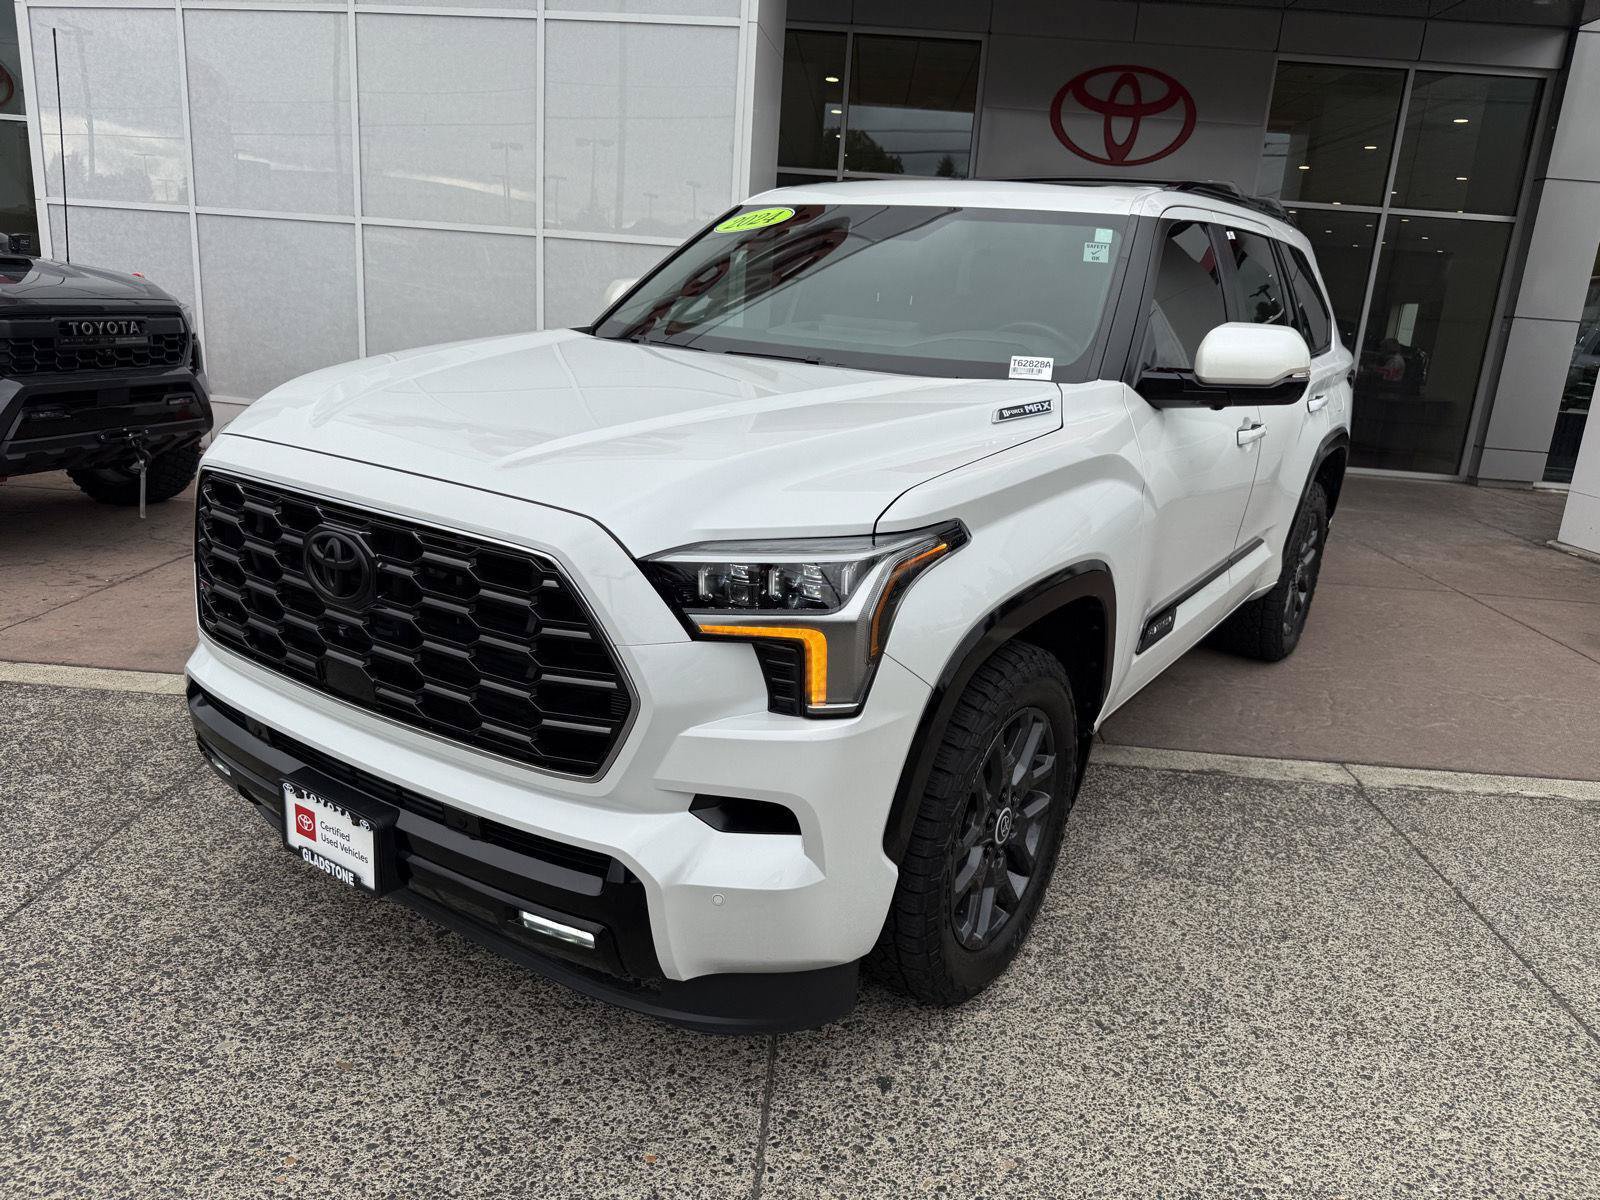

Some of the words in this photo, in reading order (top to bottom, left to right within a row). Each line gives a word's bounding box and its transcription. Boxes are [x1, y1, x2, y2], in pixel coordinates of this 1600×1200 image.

[721, 210, 787, 230] 2024
[68, 320, 141, 336] TOYOTA
[1012, 359, 1052, 369] T62828A
[1024, 401, 1051, 413] MAX
[320, 820, 351, 842] Certified
[320, 832, 339, 850] Used
[339, 841, 369, 864] Vehicles
[302, 847, 356, 887] GLADSTONE
